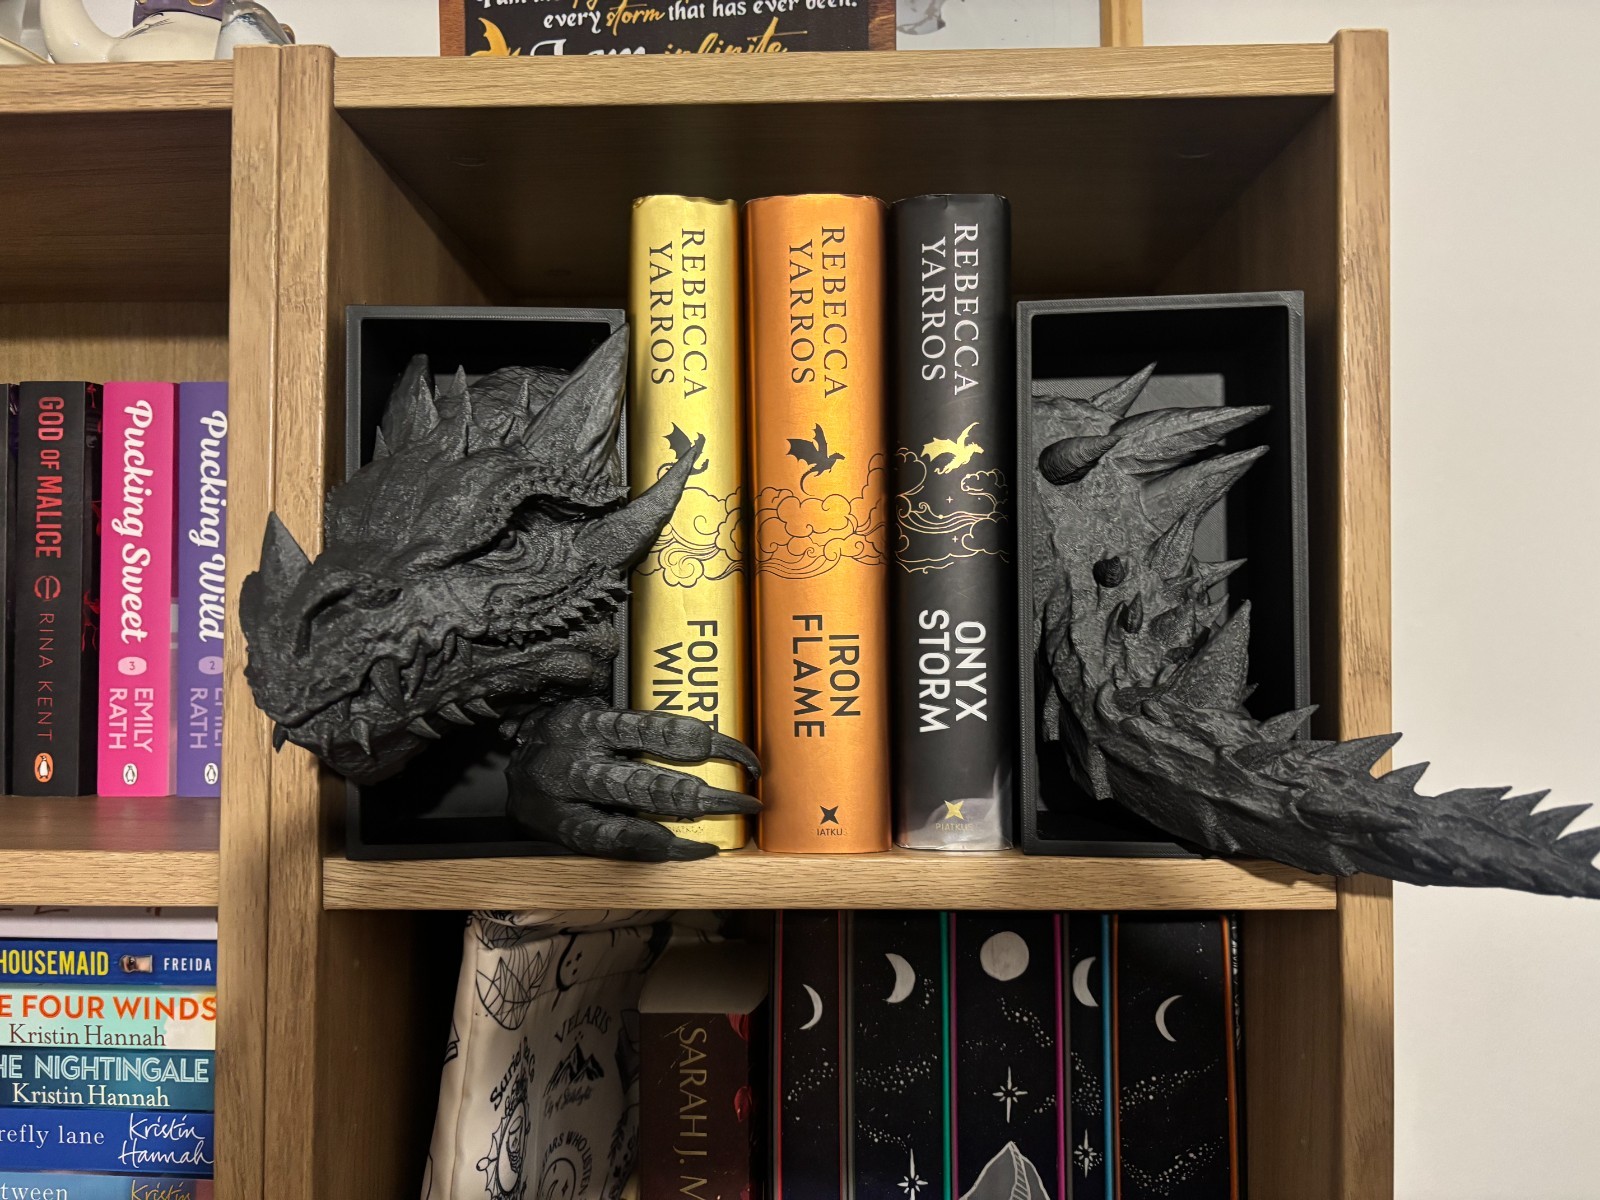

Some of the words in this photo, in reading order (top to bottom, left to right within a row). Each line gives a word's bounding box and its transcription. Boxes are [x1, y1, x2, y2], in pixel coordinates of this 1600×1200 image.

[543, 9, 601, 34] every
[606, 0, 666, 36] storm
[668, 3, 705, 21] that
[712, 1, 747, 17] has
[753, 0, 799, 14] ever
[649, 240, 675, 385] YARROS
[681, 228, 707, 399] REBECCA
[789, 239, 815, 384] YARROS
[821, 226, 848, 398] REBECCA
[921, 236, 946, 381] YARROS
[954, 223, 979, 395] REBECCA
[38, 397, 65, 441] GOD
[40, 450, 60, 470] OF
[112, 400, 153, 538] Pucking
[188, 410, 228, 548] Pucking
[35, 476, 63, 558] MALICE
[121, 543, 152, 644] Sweet
[198, 553, 226, 642] Wild
[38, 613, 55, 669] RINA
[129, 662, 136, 670] 3
[210, 661, 215, 670] 2
[918, 609, 950, 733] STORM
[955, 621, 987, 722] ONYX
[653, 642, 683, 710] WIN
[687, 621, 718, 734] FOURT
[792, 614, 825, 738] FLAME
[829, 634, 860, 717] IRON
[37, 681, 54, 741] KENT
[108, 688, 128, 749] RATH
[133, 688, 154, 753] EMILY
[190, 688, 208, 749] RATH
[0, 950, 109, 975] HOUSEMAID
[163, 957, 212, 972] FREIDA
[9, 1023, 79, 1045] Kristin
[84, 1025, 167, 1046] Hannah
[22, 994, 105, 1019] FOUR
[112, 996, 217, 1021] WINDS
[11, 1082, 84, 1105] Kristin
[87, 1085, 170, 1107] Hannah
[35, 1055, 209, 1083] NIGHTINGALE
[679, 1027, 708, 1137] SARAH
[58, 1125, 105, 1145] lane
[118, 1138, 215, 1169] Hannah
[129, 1112, 206, 1141] Kristin
[673, 1145, 708, 1165] J.
